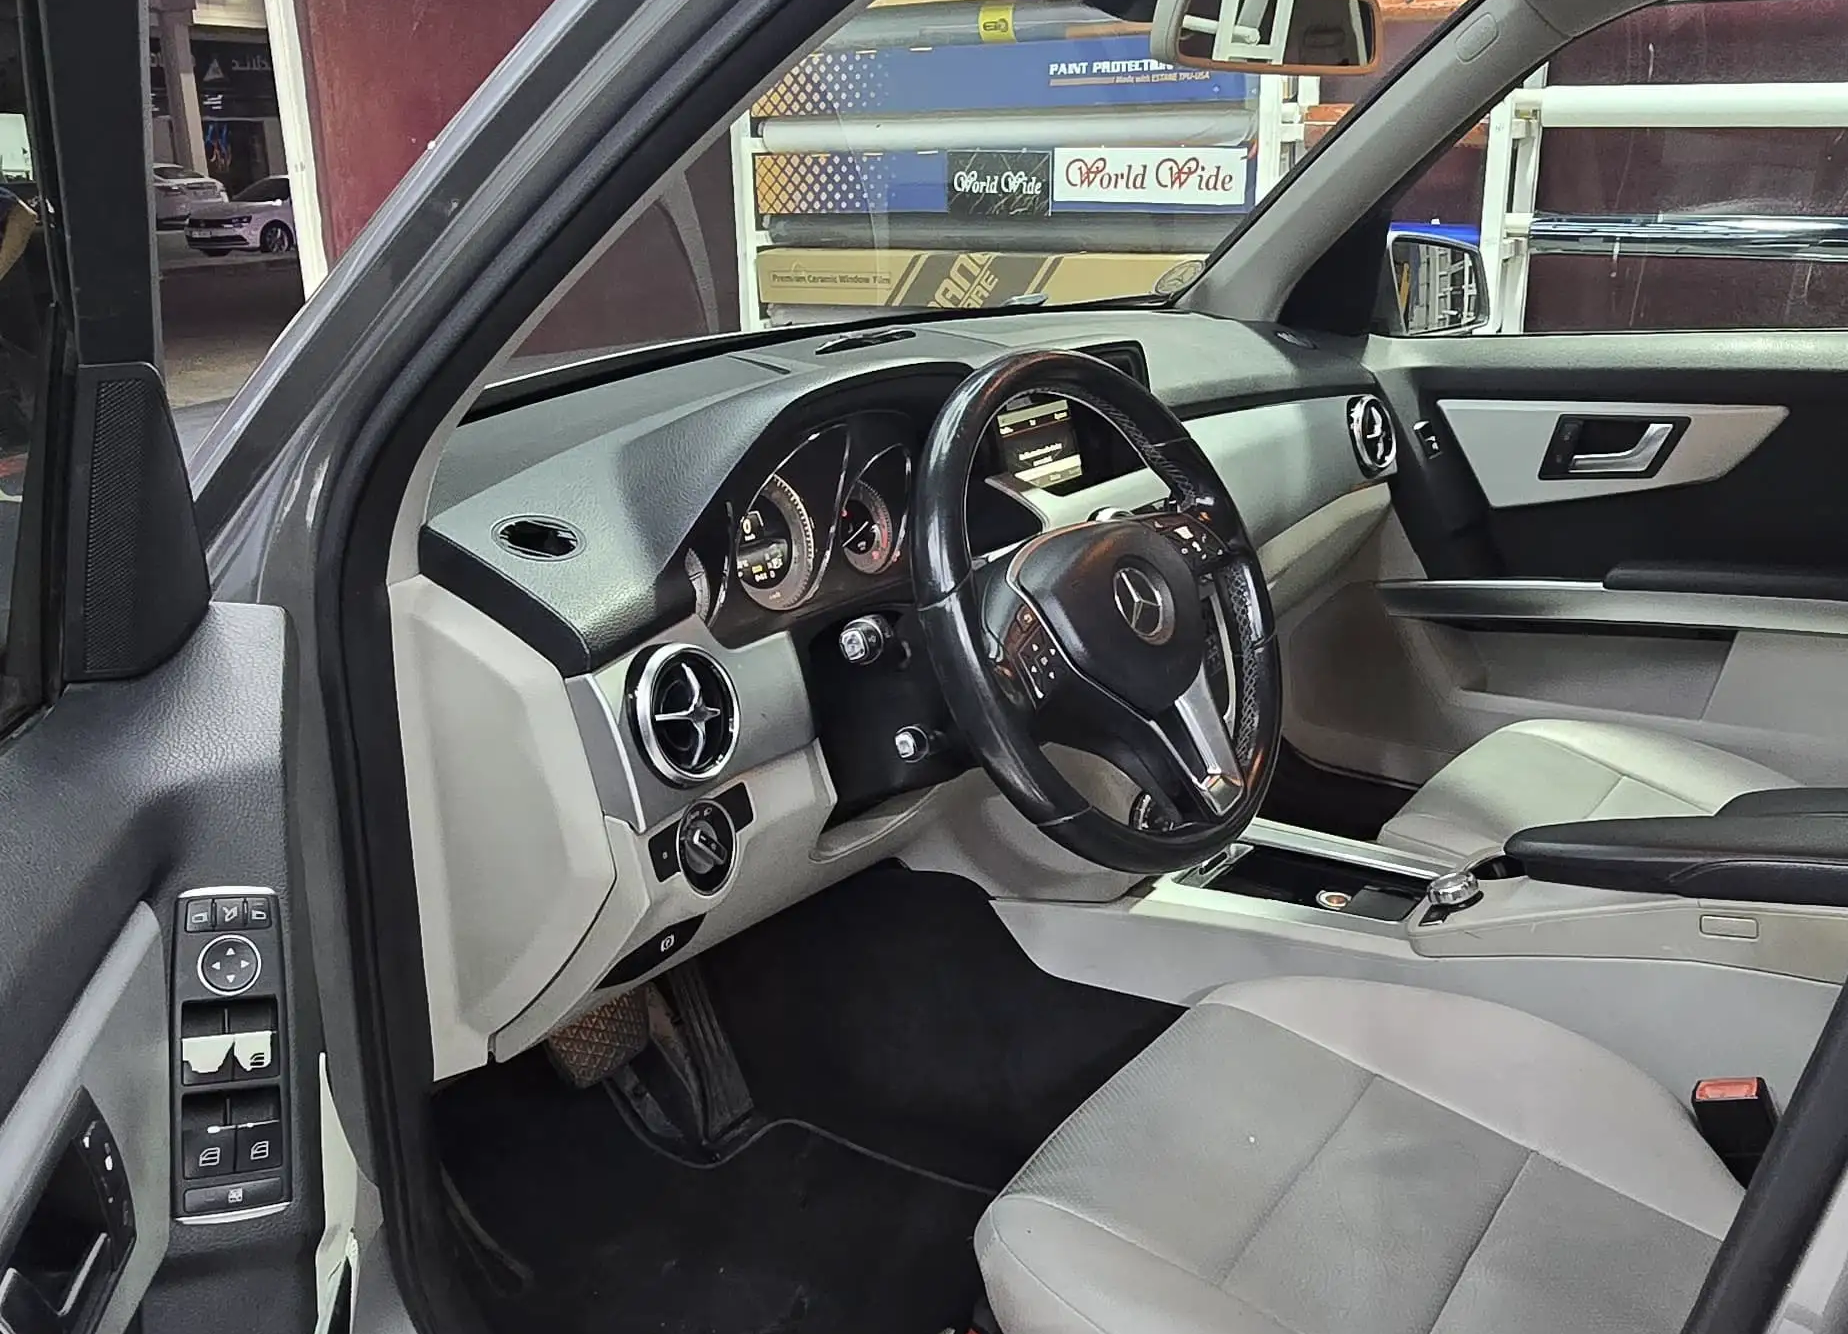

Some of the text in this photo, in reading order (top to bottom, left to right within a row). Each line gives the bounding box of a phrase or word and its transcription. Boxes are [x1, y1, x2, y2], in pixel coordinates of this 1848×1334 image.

[1049, 63, 1089, 75] PAINT
[1135, 75, 1151, 83] with
[1065, 157, 1233, 192] World Wide
[953, 170, 1042, 195] World Wide
[807, 274, 837, 284] Ceramic
[838, 274, 869, 284] Window
